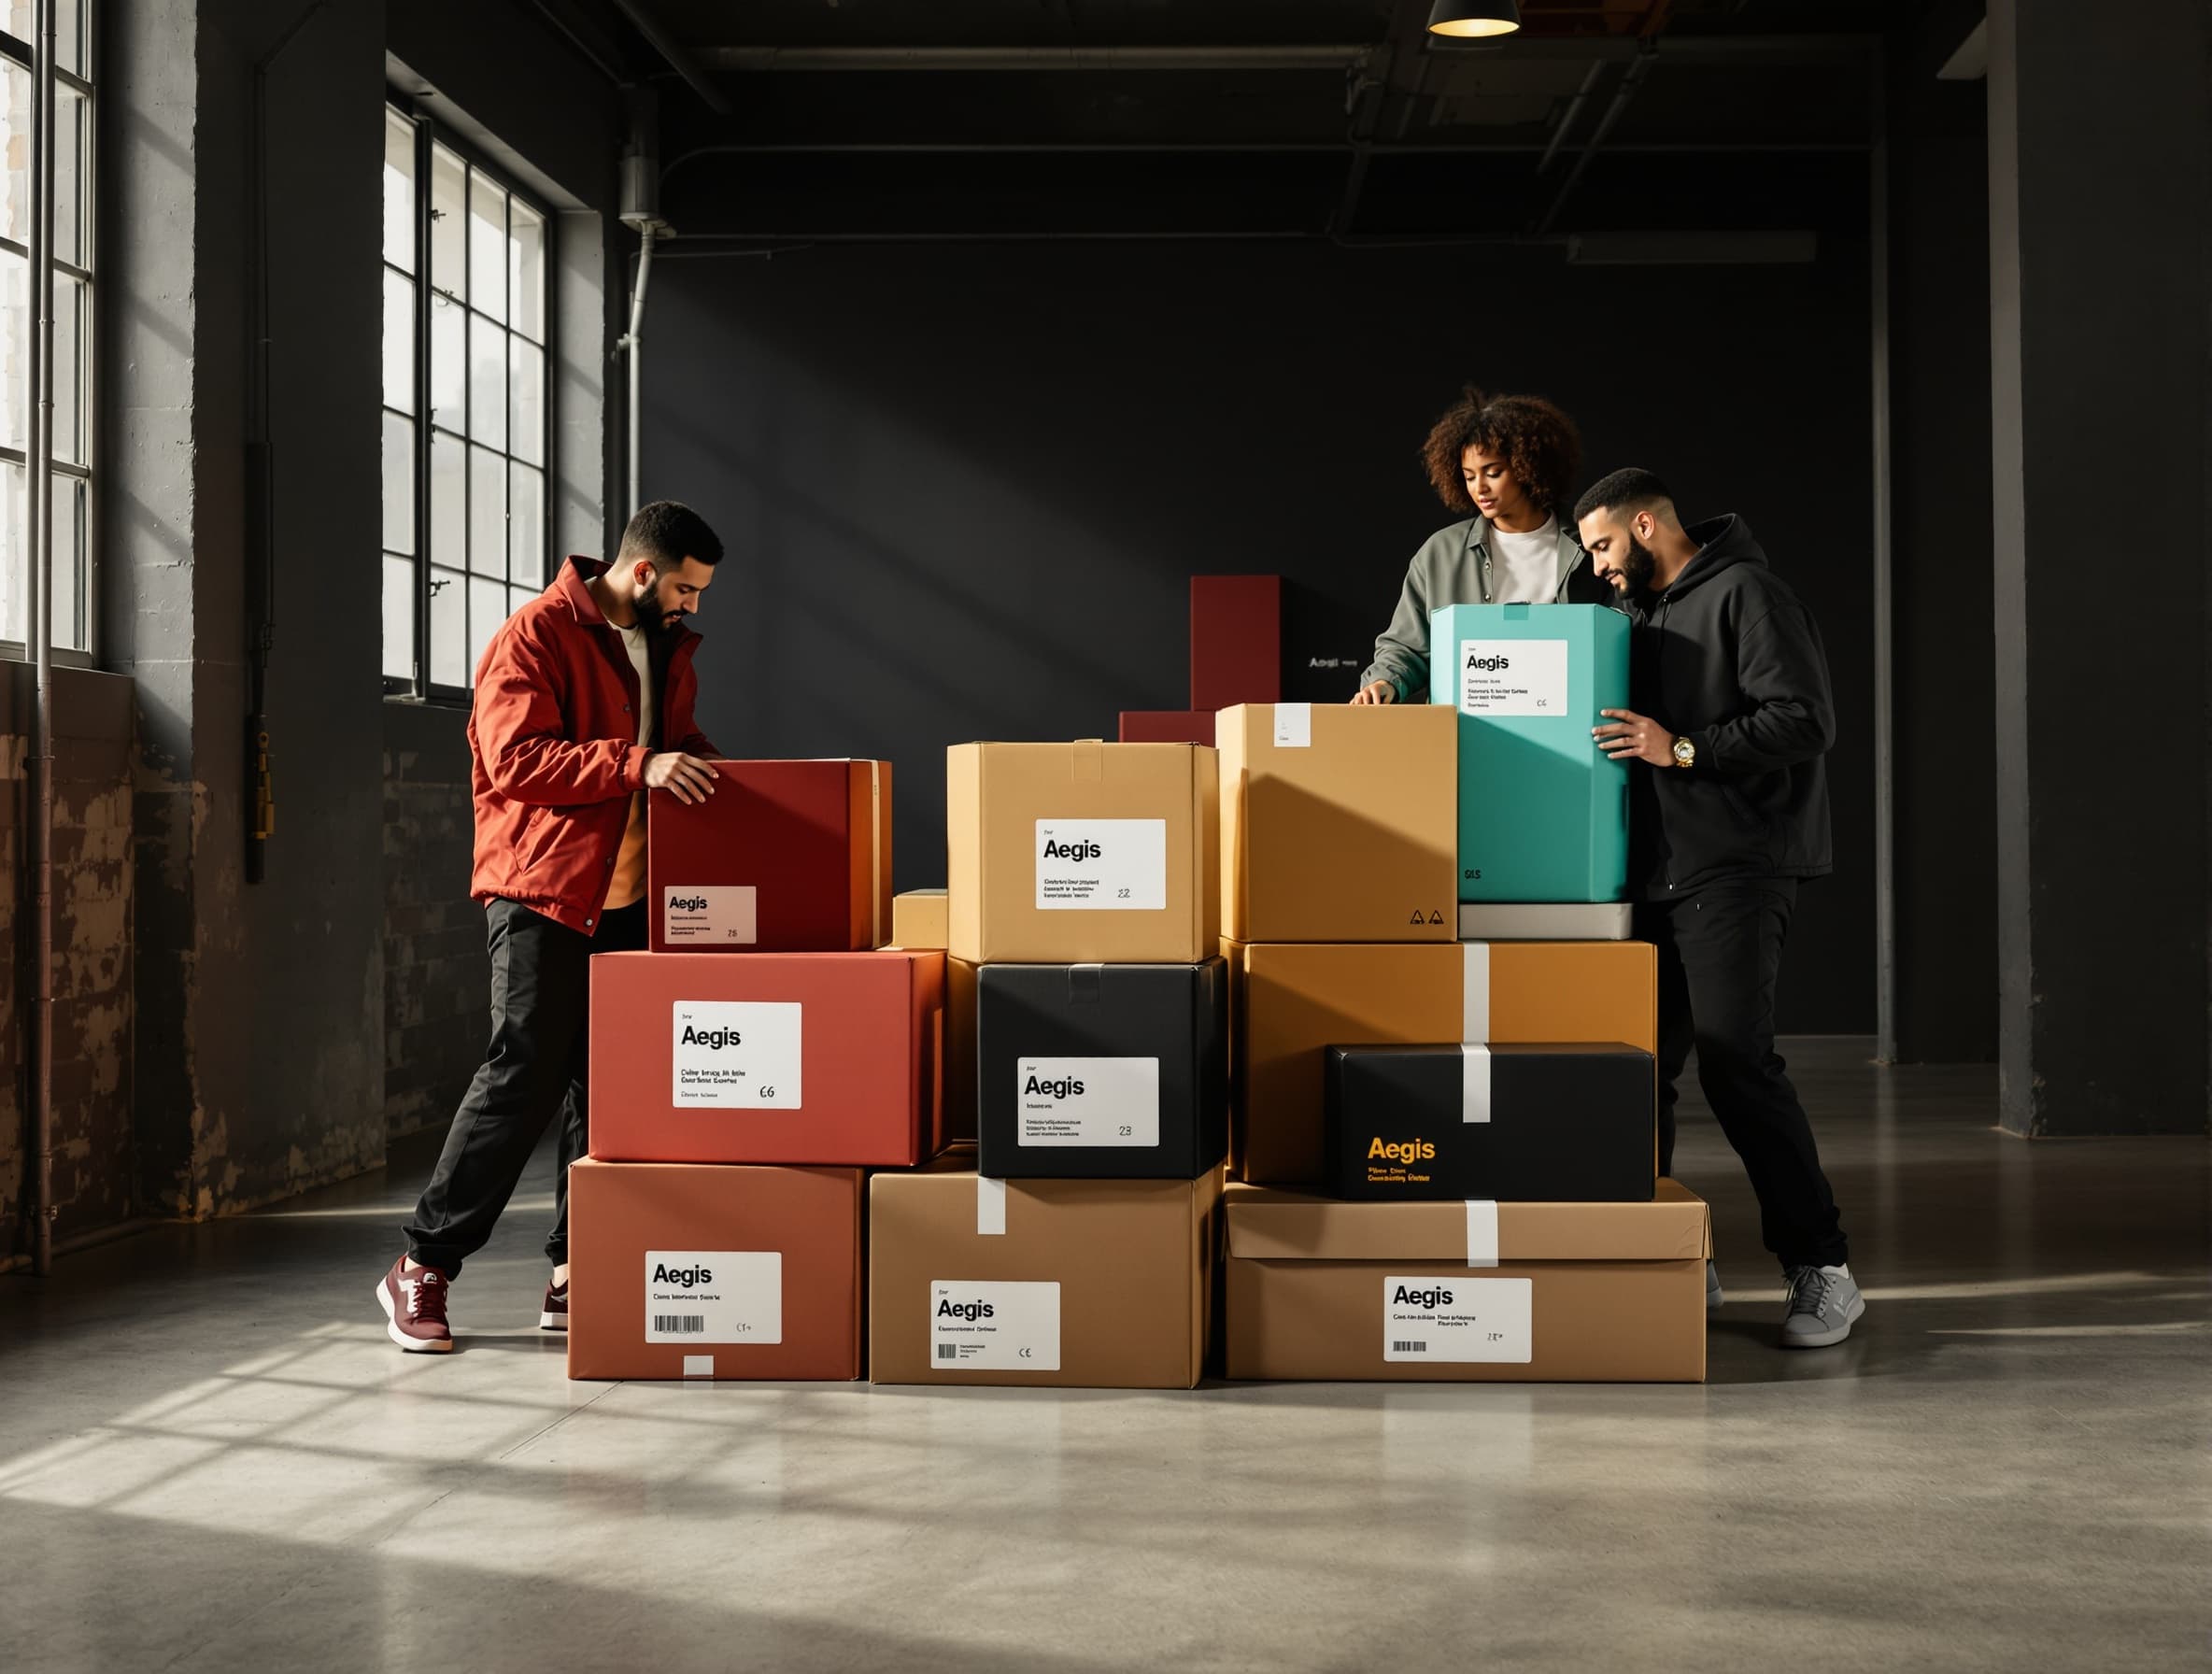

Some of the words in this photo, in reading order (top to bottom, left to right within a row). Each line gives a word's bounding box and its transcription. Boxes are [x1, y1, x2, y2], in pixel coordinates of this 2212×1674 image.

[1467, 655, 1510, 672] Aegis
[1043, 840, 1101, 862] Aegis
[669, 896, 708, 912] Aegis
[681, 1026, 742, 1050] Aegis
[1024, 1075, 1085, 1099] Aegis
[1368, 1137, 1436, 1164] Aegis
[653, 1264, 713, 1288] Aegis
[1393, 1285, 1453, 1310] Aegis
[937, 1298, 995, 1322] Aegis
